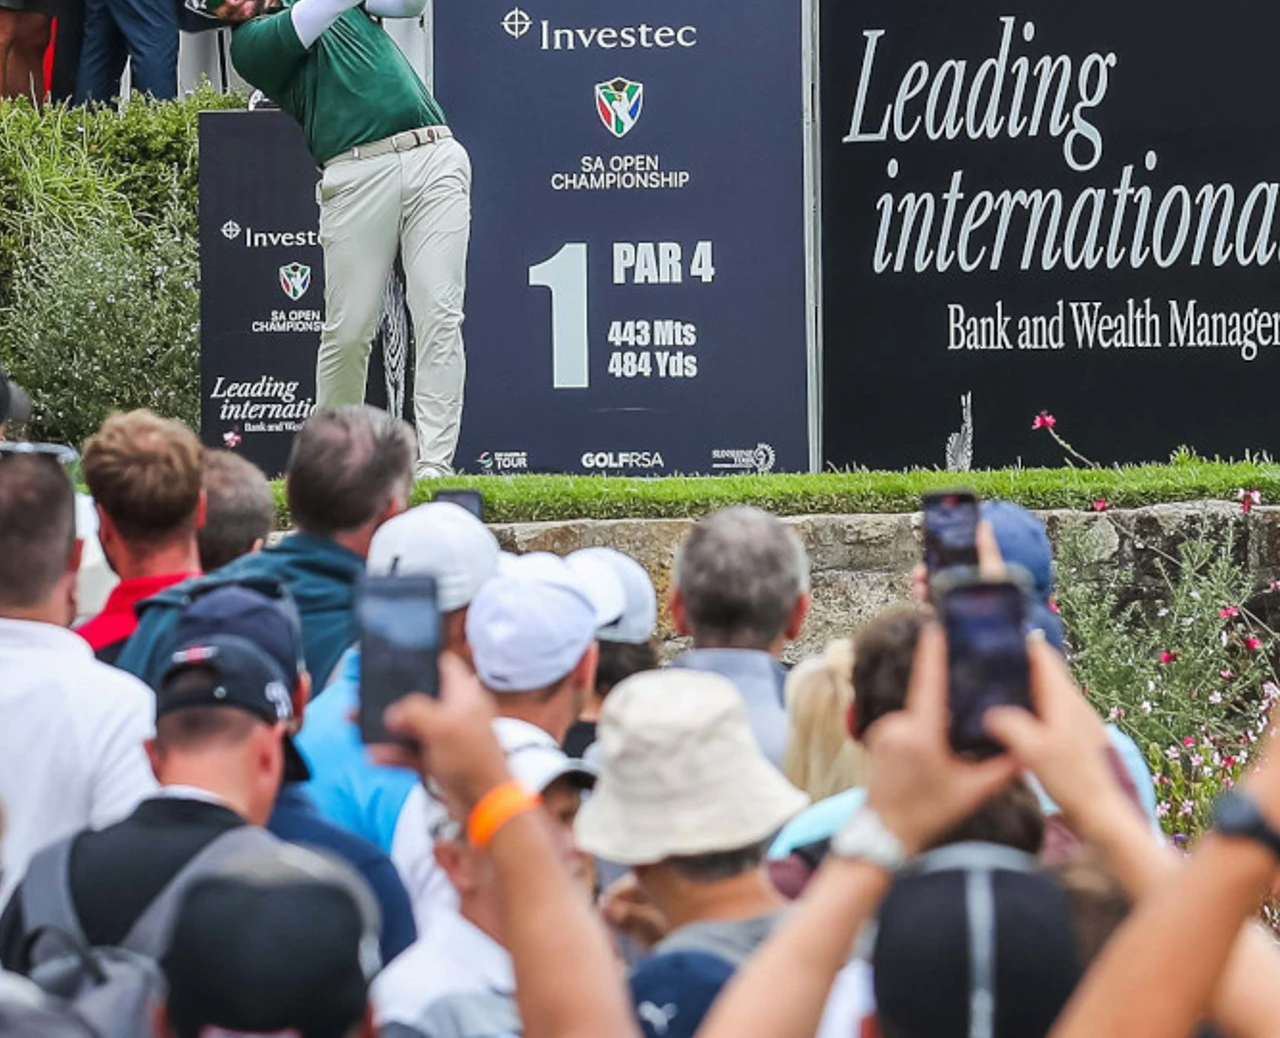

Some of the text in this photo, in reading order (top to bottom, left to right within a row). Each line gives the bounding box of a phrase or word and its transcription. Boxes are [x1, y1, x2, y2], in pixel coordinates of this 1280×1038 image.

[540, 18, 697, 51] Investec
[842, 16, 1117, 171] Leading
[581, 155, 660, 172] SA OPEN
[551, 171, 690, 190] CHAMPIONSHIP
[246, 227, 322, 248] Invest
[613, 240, 715, 284] PAR 4
[251, 321, 323, 333] CHAMPIONS
[271, 310, 321, 321] SA OPEN
[528, 242, 589, 389] 1
[947, 302, 1013, 351] Bank
[1018, 300, 1065, 349] and
[1070, 298, 1162, 349] Wealth
[607, 320, 697, 348] 443 Mts
[607, 351, 698, 379] 484 Yds
[210, 375, 300, 403] Leading
[220, 398, 318, 421] internati
[494, 457, 528, 470] TOUR
[581, 451, 664, 468] GOLFRSA
